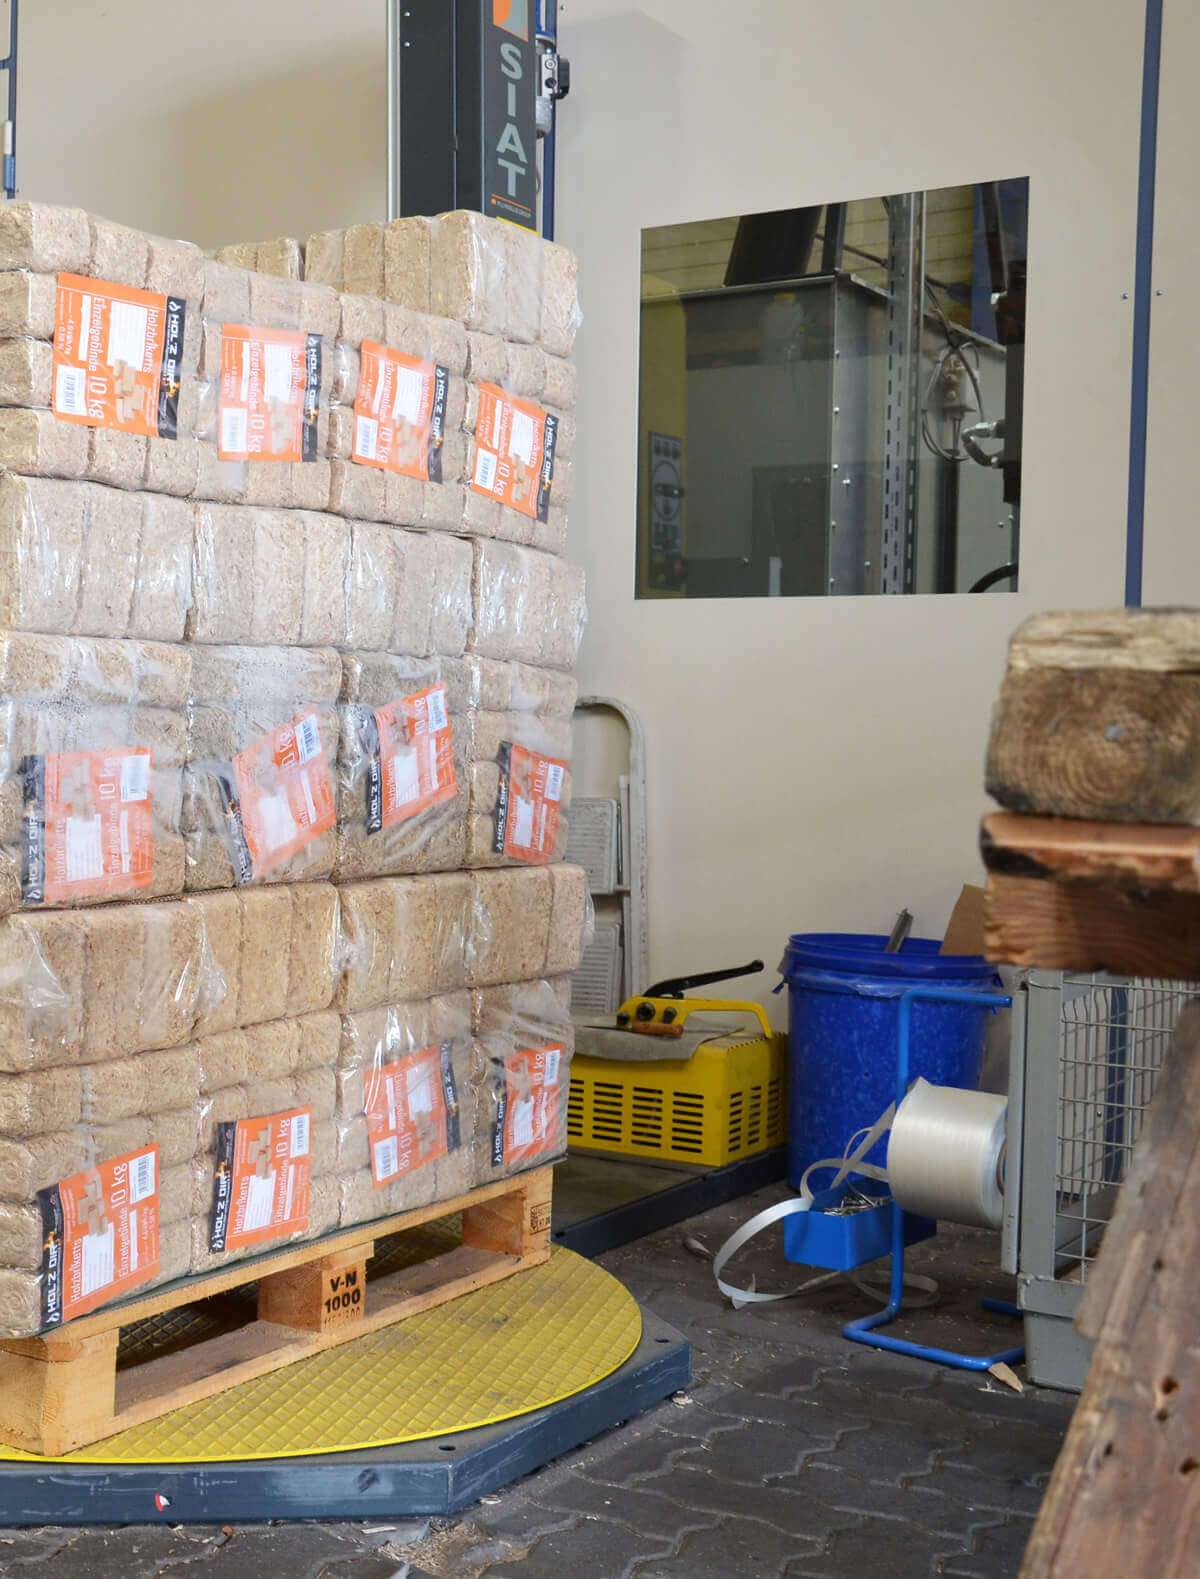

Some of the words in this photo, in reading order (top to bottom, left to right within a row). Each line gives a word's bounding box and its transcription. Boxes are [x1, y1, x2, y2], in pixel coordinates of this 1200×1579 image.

[496, 43, 528, 197] SIAT
[88, 297, 107, 371] Einzelgebinde
[143, 309, 159, 373] Holzbriketts
[166, 359, 176, 383] DIR
[90, 376, 107, 394] 10
[88, 399, 104, 419] kg
[251, 414, 264, 429] 10
[248, 435, 264, 452] kg
[381, 426, 393, 442] 10
[376, 446, 391, 463] kg
[497, 462, 510, 477] 10
[494, 480, 507, 496] kg
[99, 784, 116, 800] 10
[534, 780, 544, 792] 10
[29, 815, 39, 840] DIR
[279, 1118, 290, 1137] kg
[275, 1142, 288, 1158] 10
[111, 1163, 127, 1185] kg
[219, 1175, 227, 1197] DIR
[111, 1189, 126, 1207] 10
[233, 1176, 248, 1234] Holzbriketts
[118, 1206, 130, 1277] Einzelgebinde
[48, 1242, 58, 1268] DIR
[70, 1239, 81, 1302] Holzbriketts
[48, 1272, 56, 1312] HOL'Z
[330, 1271, 357, 1292] V-N
[325, 1288, 361, 1313] 1000
